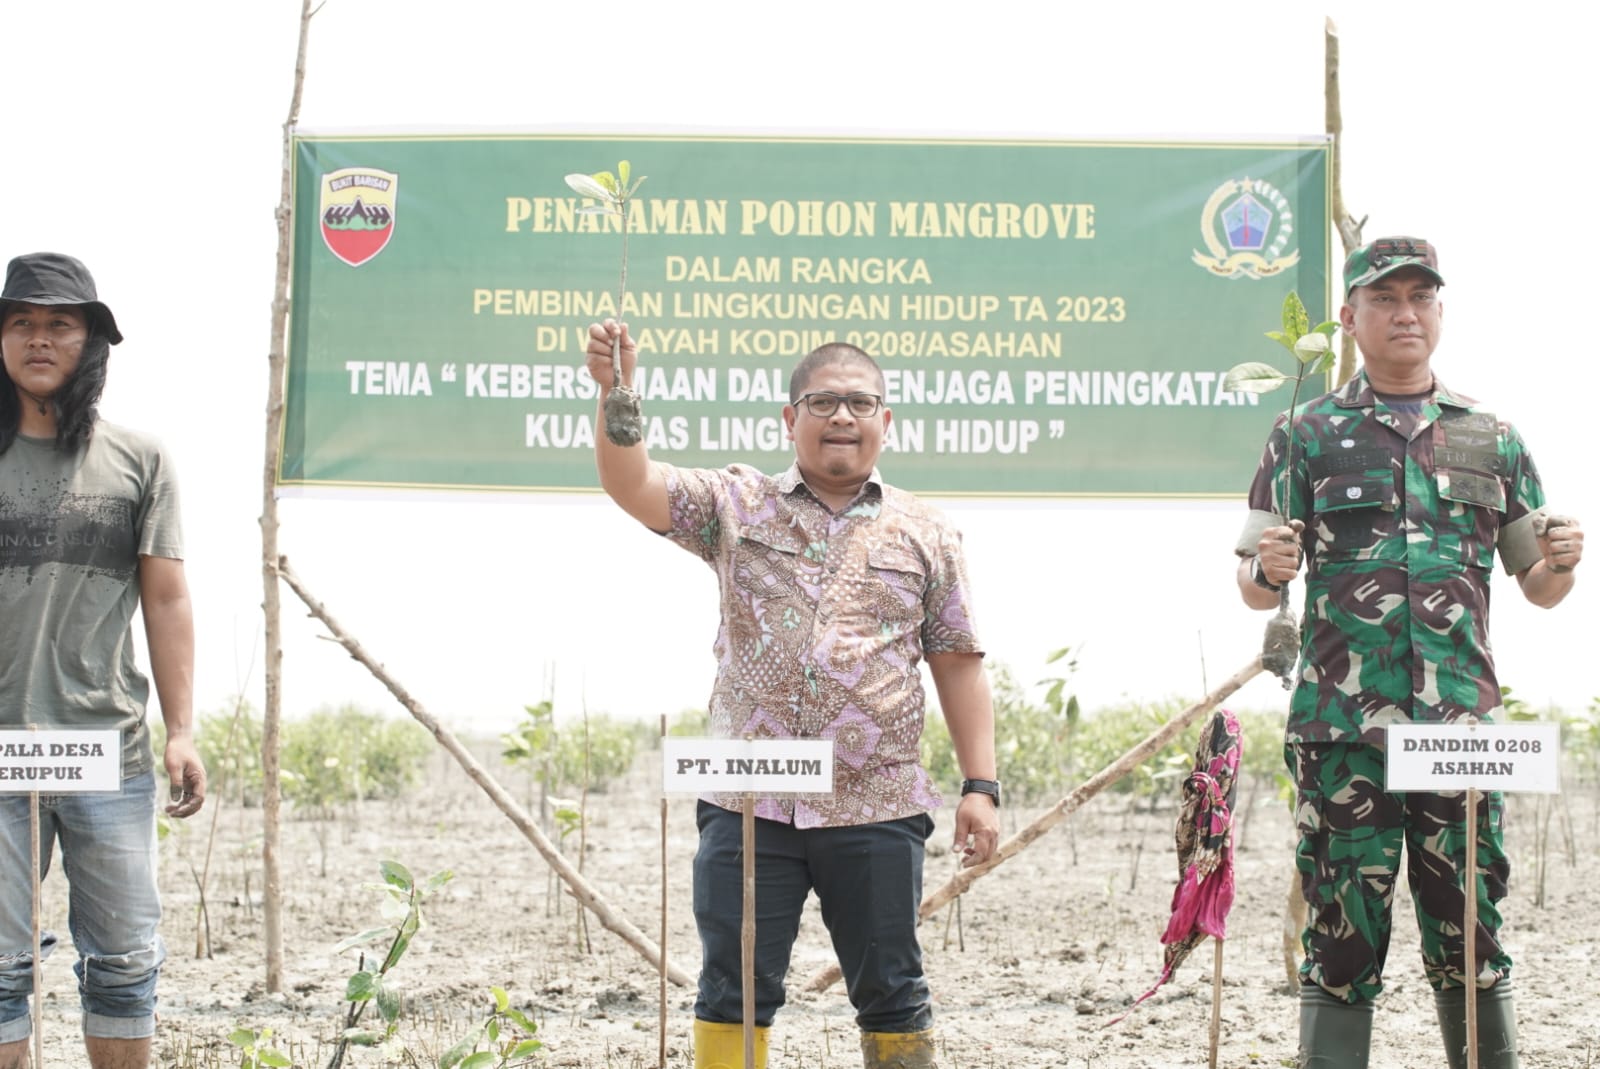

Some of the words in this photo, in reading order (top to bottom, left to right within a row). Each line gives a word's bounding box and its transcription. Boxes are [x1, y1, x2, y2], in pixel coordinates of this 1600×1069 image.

[505, 197, 728, 235] PENANAMAN
[740, 199, 877, 237] POHON
[889, 201, 1097, 240] MANGROVE
[665, 255, 780, 283] DALAM
[791, 257, 932, 285] RANGKA
[473, 288, 663, 318] PEMBINAAN
[674, 291, 890, 320] LINGKUNGAN
[901, 294, 1000, 321] HIDUP
[1008, 295, 1049, 322] TA
[1056, 295, 1127, 323] 2023
[536, 326, 567, 352] DI
[575, 327, 719, 354] AYAH
[846, 330, 1062, 358] 0208/ASAHAN
[345, 360, 433, 397] TEMA
[465, 363, 717, 401] KEBERSMAAN
[728, 367, 790, 402] DAL
[882, 369, 1016, 404] ENJAGA
[525, 413, 689, 450] KUAAS
[699, 416, 925, 453] LINGAN
[936, 418, 1040, 454] HIDUP
[0, 743, 44, 757] ALA
[49, 743, 105, 757] DESA
[1403, 738, 1489, 752] DANDIM
[1495, 739, 1542, 753] 0208
[676, 758, 719, 775] PT.
[726, 758, 821, 776] INALUM
[1431, 761, 1514, 776] ASAHAN
